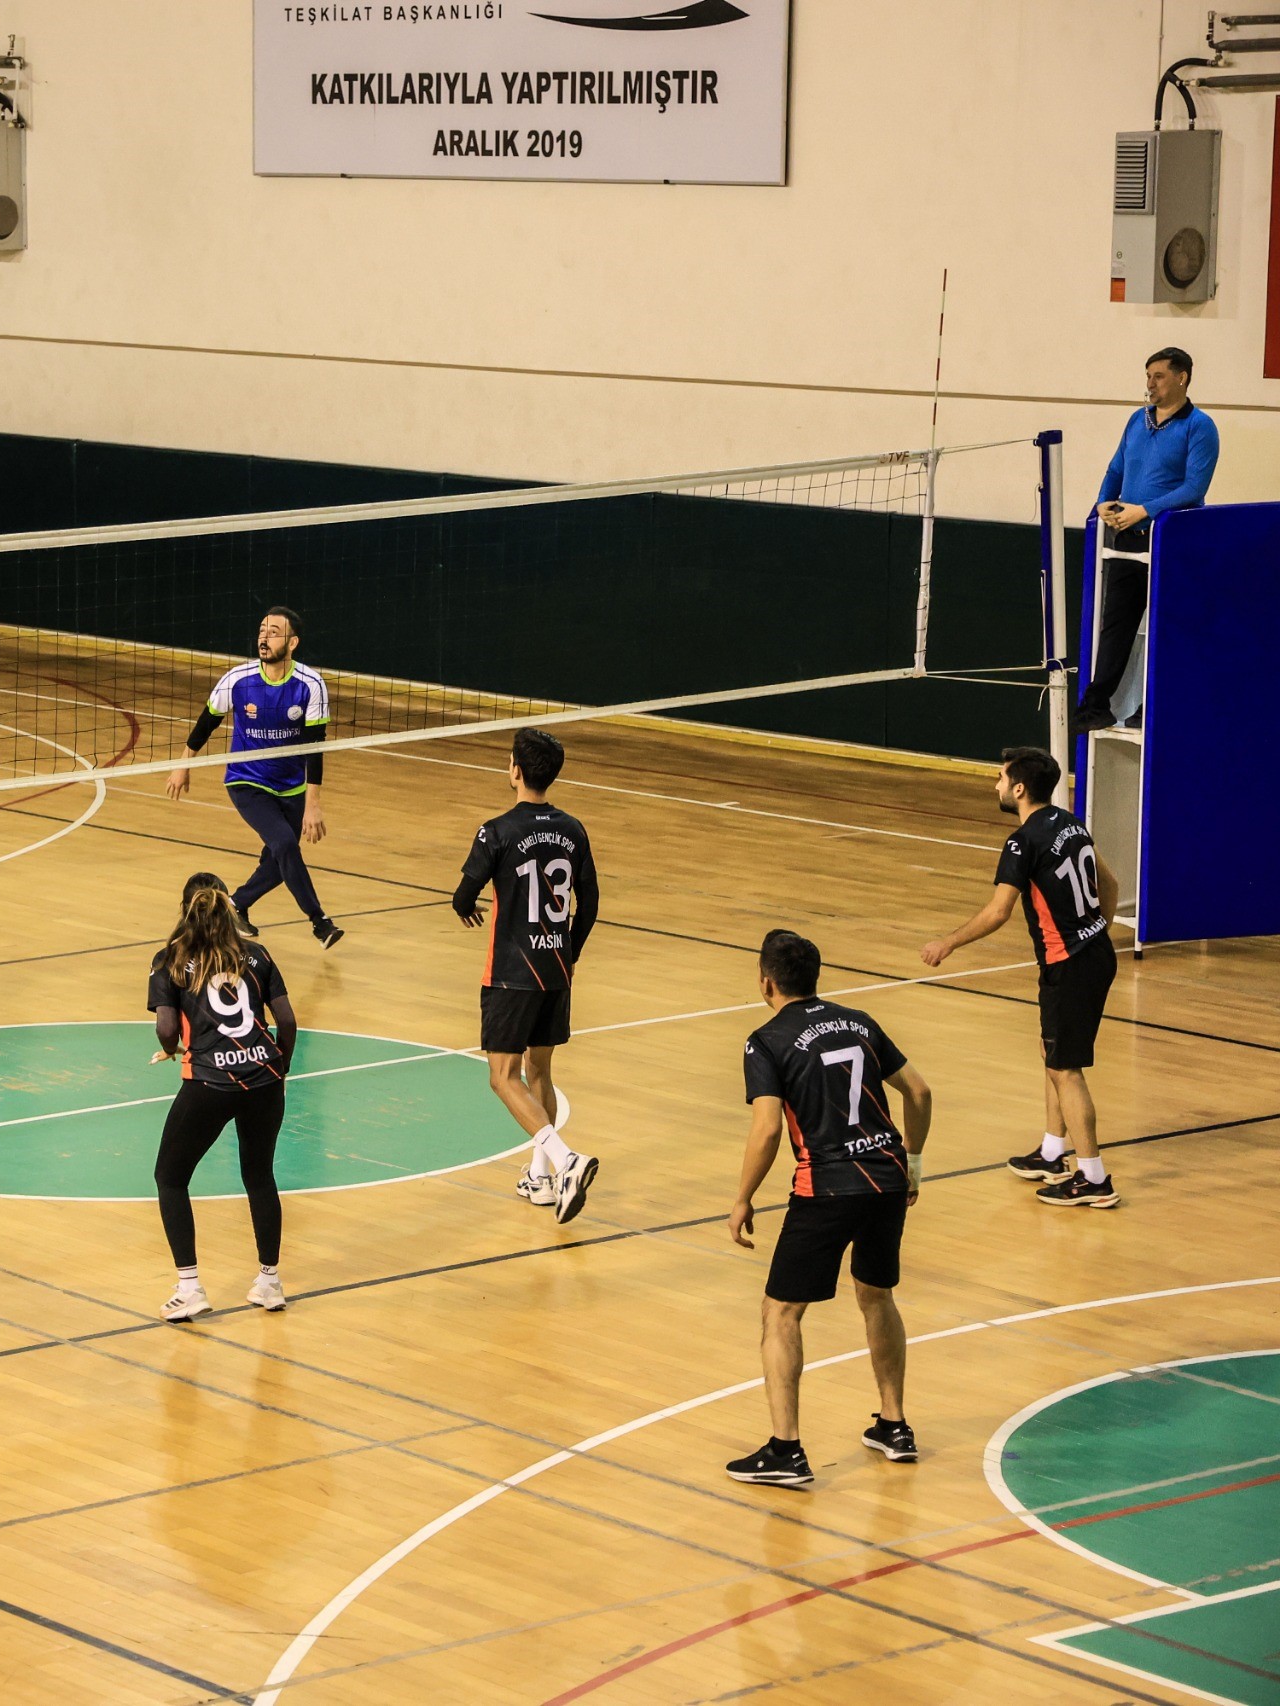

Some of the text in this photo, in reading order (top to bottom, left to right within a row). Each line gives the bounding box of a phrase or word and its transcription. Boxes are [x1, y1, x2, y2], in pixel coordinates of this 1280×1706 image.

[284, 2, 503, 25] TEŞKİLAT BAŞKANLIĞI
[311, 70, 719, 114] KATKILARIYLA YAPTIRILMIŞTIR
[433, 130, 583, 158] ARALIK 2019
[517, 831, 576, 855] ÇAMELİ GENÇLİK SPOR
[515, 858, 573, 923] 13
[1054, 844, 1100, 917] 10
[528, 930, 563, 950] YASİN
[206, 972, 255, 1038] 9
[793, 1017, 869, 1052] ÇAMELİ GENÇLİK SPOR
[213, 1045, 269, 1067] BODUR
[820, 1045, 865, 1126] 7
